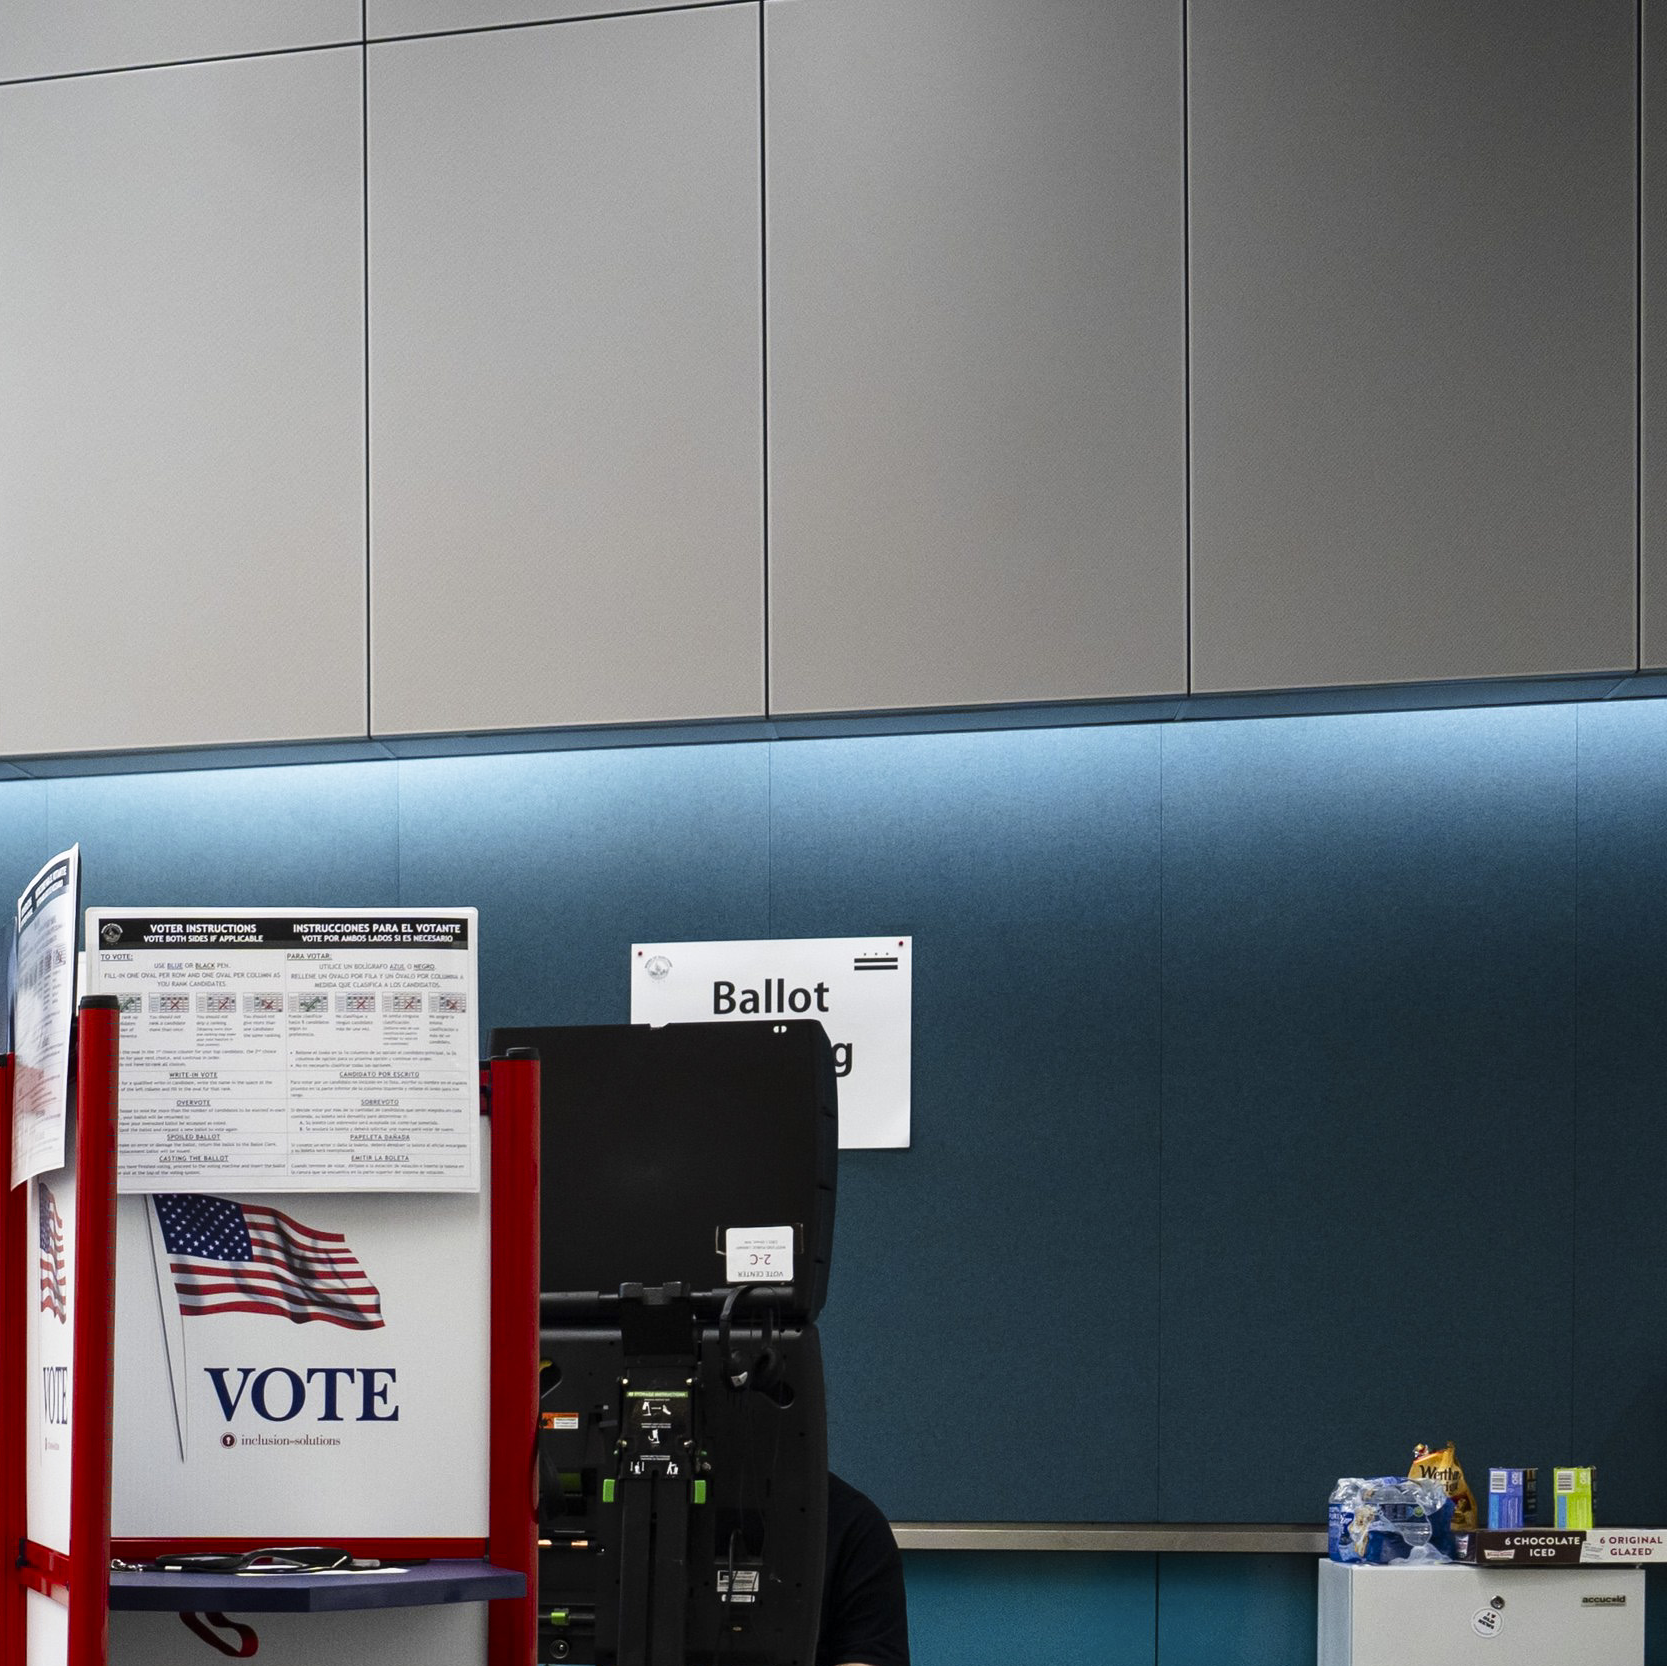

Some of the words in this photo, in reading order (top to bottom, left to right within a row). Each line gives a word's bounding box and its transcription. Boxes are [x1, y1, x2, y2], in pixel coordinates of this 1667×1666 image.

[149, 923, 184, 934] VOTER
[185, 923, 257, 934] INSTRUCTIONS
[292, 923, 371, 934] INSTRUCCIONES
[372, 923, 399, 933] PARA
[401, 923, 414, 933] EL
[415, 923, 461, 934] VOTANTE
[713, 977, 830, 1015] Ballot
[749, 1253, 772, 1266] 2-C
[737, 1270, 765, 1278] CENTER
[765, 1270, 784, 1278] VOTE
[41, 1365, 69, 1428] VOTE
[203, 1366, 400, 1423] VOTE
[1513, 1536, 1581, 1546] CHOCOLATE
[1608, 1535, 1663, 1545] ORIGINAL
[1529, 1548, 1556, 1557] ICED
[1609, 1547, 1654, 1556] GLAZED
